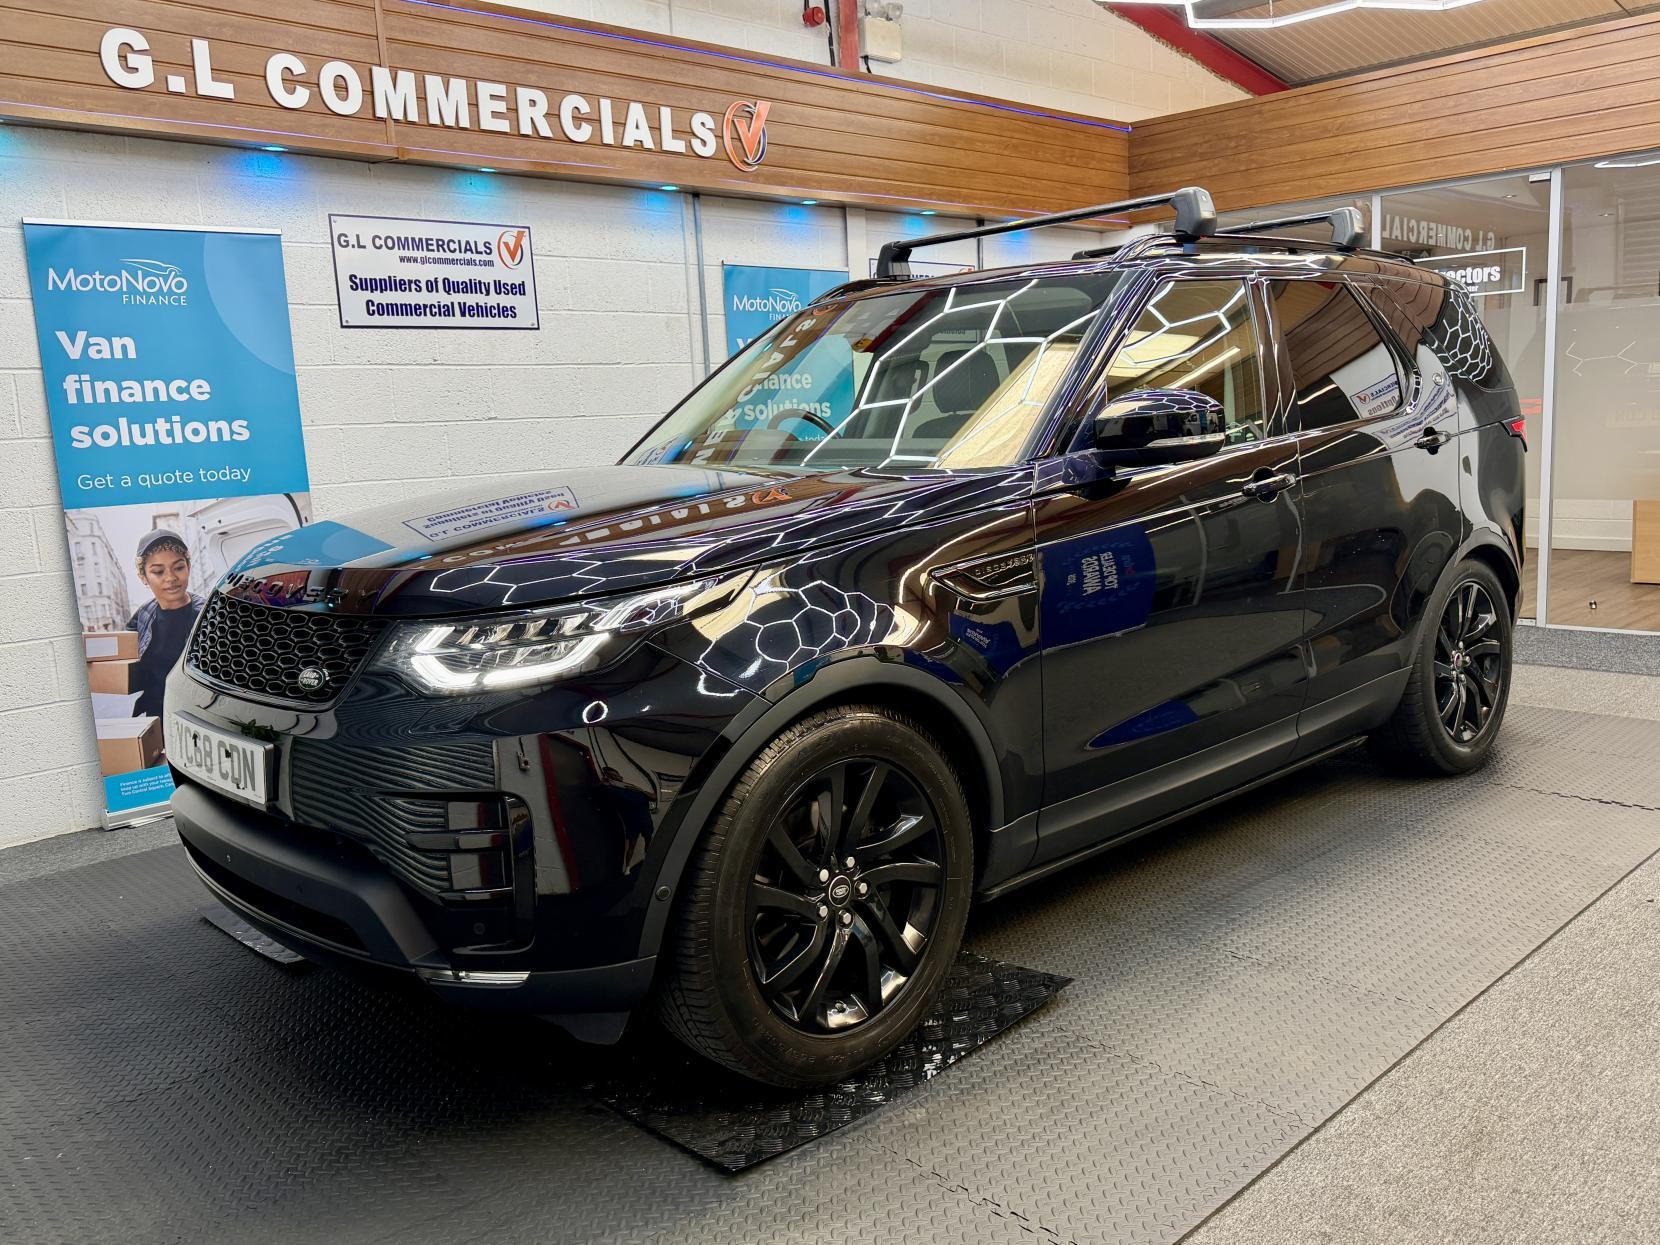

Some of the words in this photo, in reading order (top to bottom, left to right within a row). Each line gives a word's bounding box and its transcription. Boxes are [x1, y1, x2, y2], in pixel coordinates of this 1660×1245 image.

[101, 27, 235, 100] G.L
[265, 52, 716, 158] COMMERCIALS
[337, 233, 366, 250] G.L
[371, 234, 493, 256] COMMERCIALS
[398, 254, 495, 268] www.glcommercials.com
[48, 267, 188, 294] MotoNovo
[349, 274, 422, 294] Suppliers
[426, 277, 439, 293] of
[442, 277, 491, 296] Quality
[494, 279, 526, 296] Used
[123, 295, 187, 306] FINANCE
[365, 299, 455, 318] Commercial
[459, 302, 517, 319] Vehicles
[733, 294, 801, 312] MotoNovo
[55, 330, 137, 360] Van
[63, 374, 211, 404] finance
[70, 416, 250, 448] solutions
[77, 474, 113, 490] Get
[120, 476, 132, 487] a
[138, 468, 193, 488] quote
[198, 467, 251, 482] today
[217, 740, 256, 792] CDN
